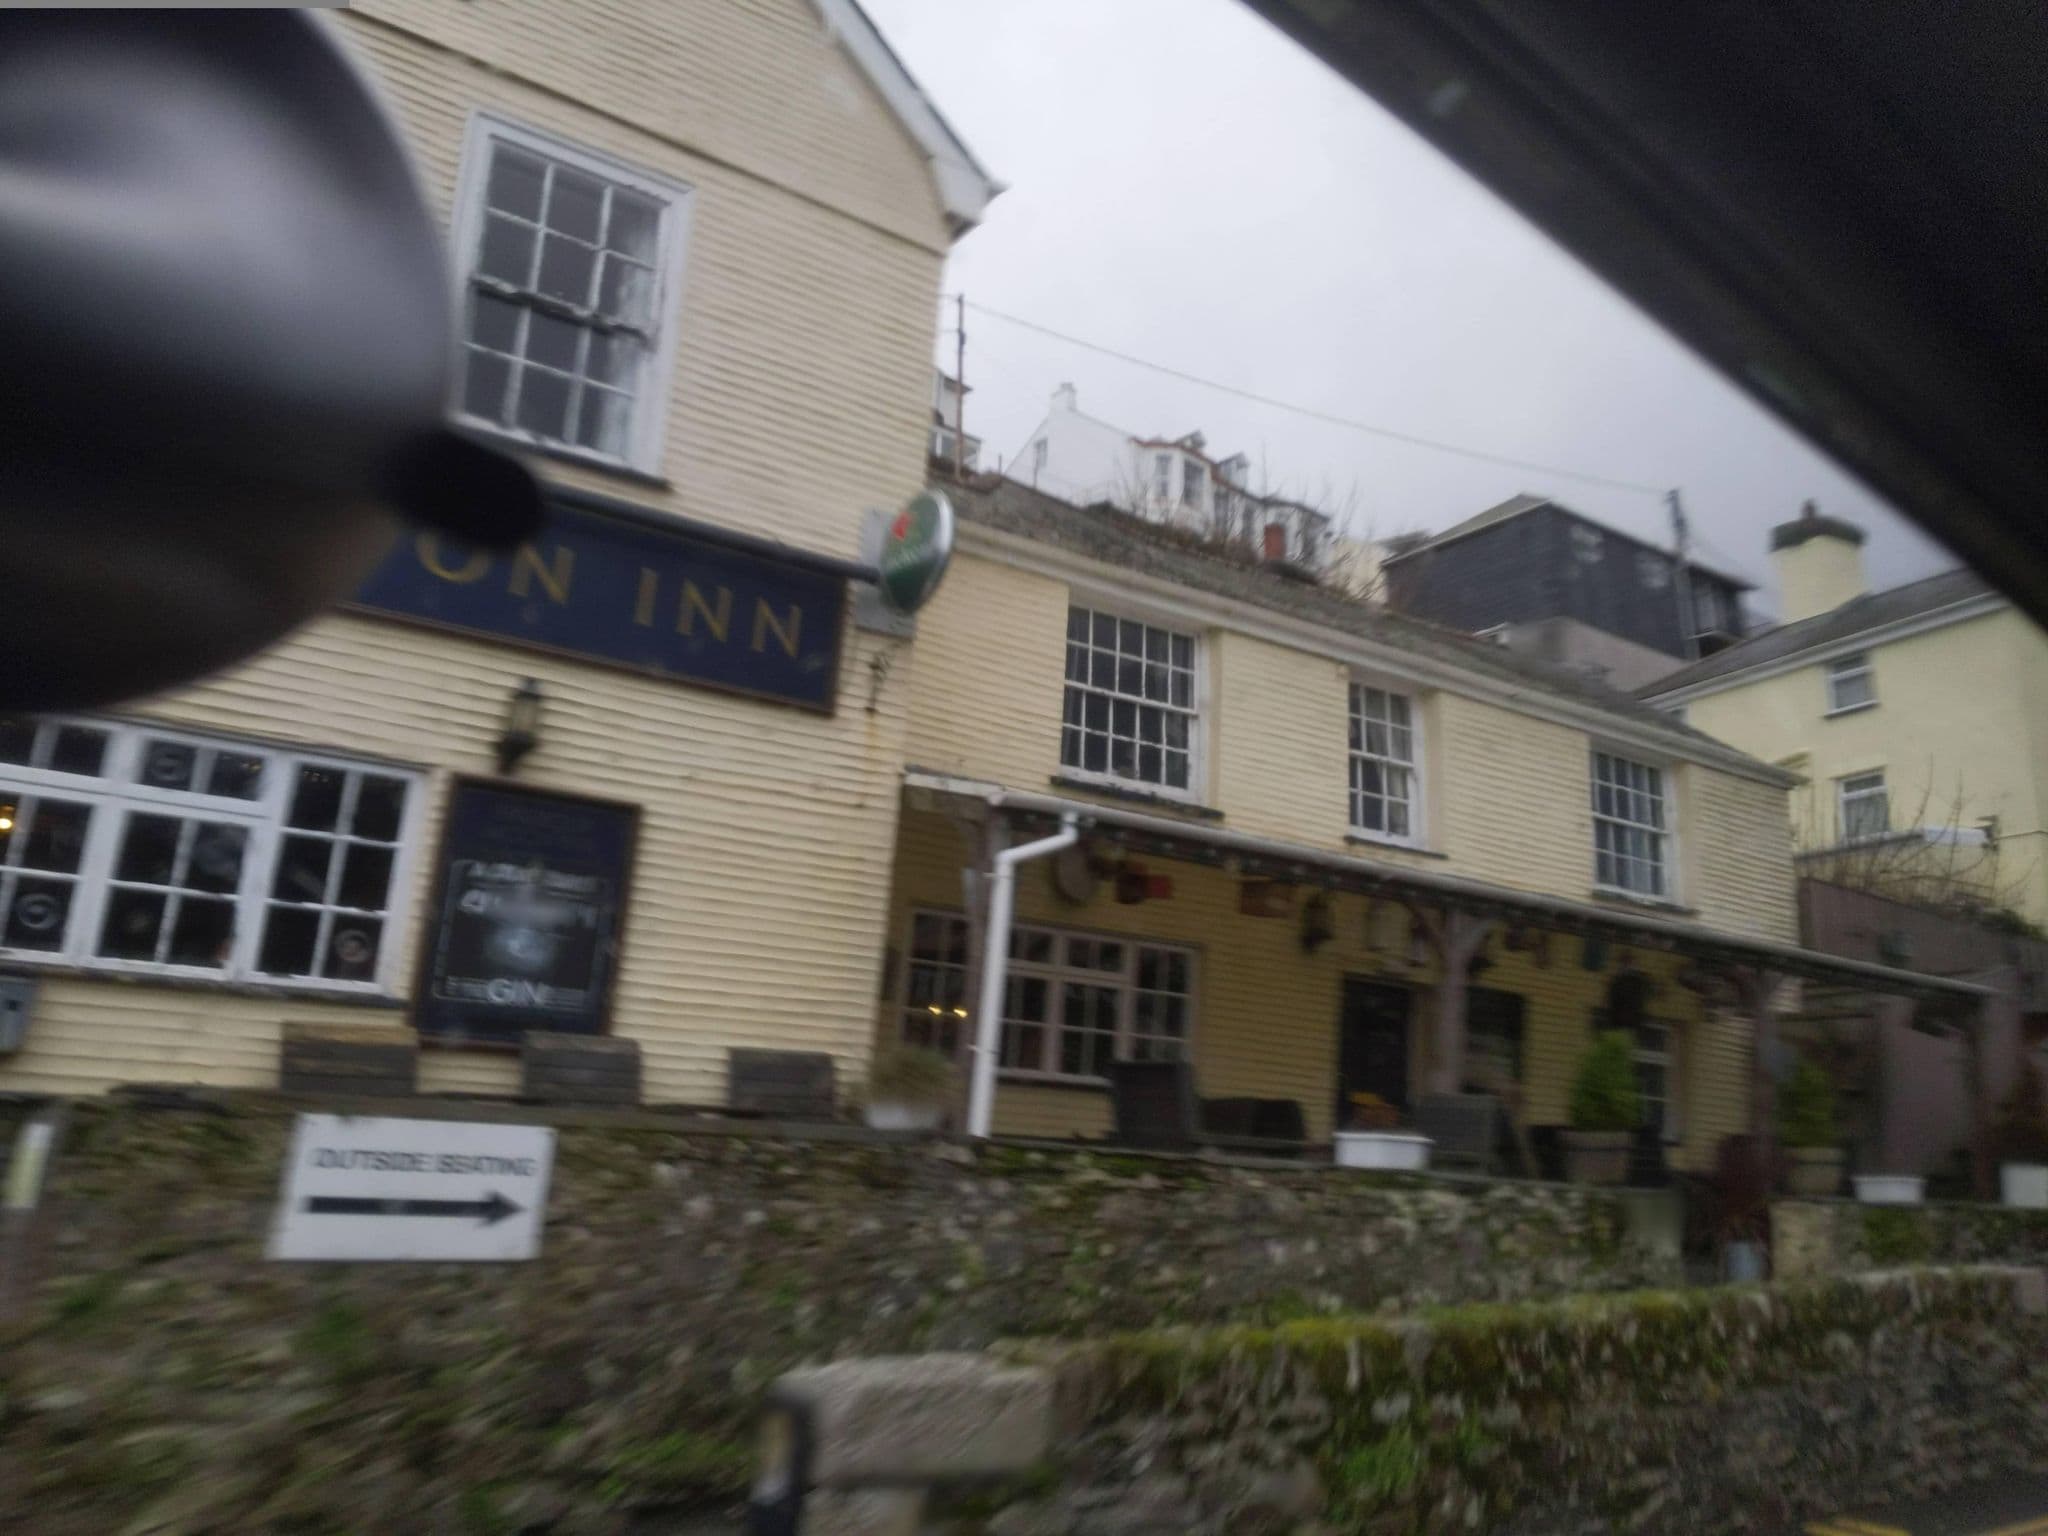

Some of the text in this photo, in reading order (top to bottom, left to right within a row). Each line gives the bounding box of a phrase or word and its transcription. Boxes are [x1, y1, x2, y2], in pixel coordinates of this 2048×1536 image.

[414, 530, 801, 658] ON INN
[314, 1147, 537, 1177] OUTSIDE SEATING
